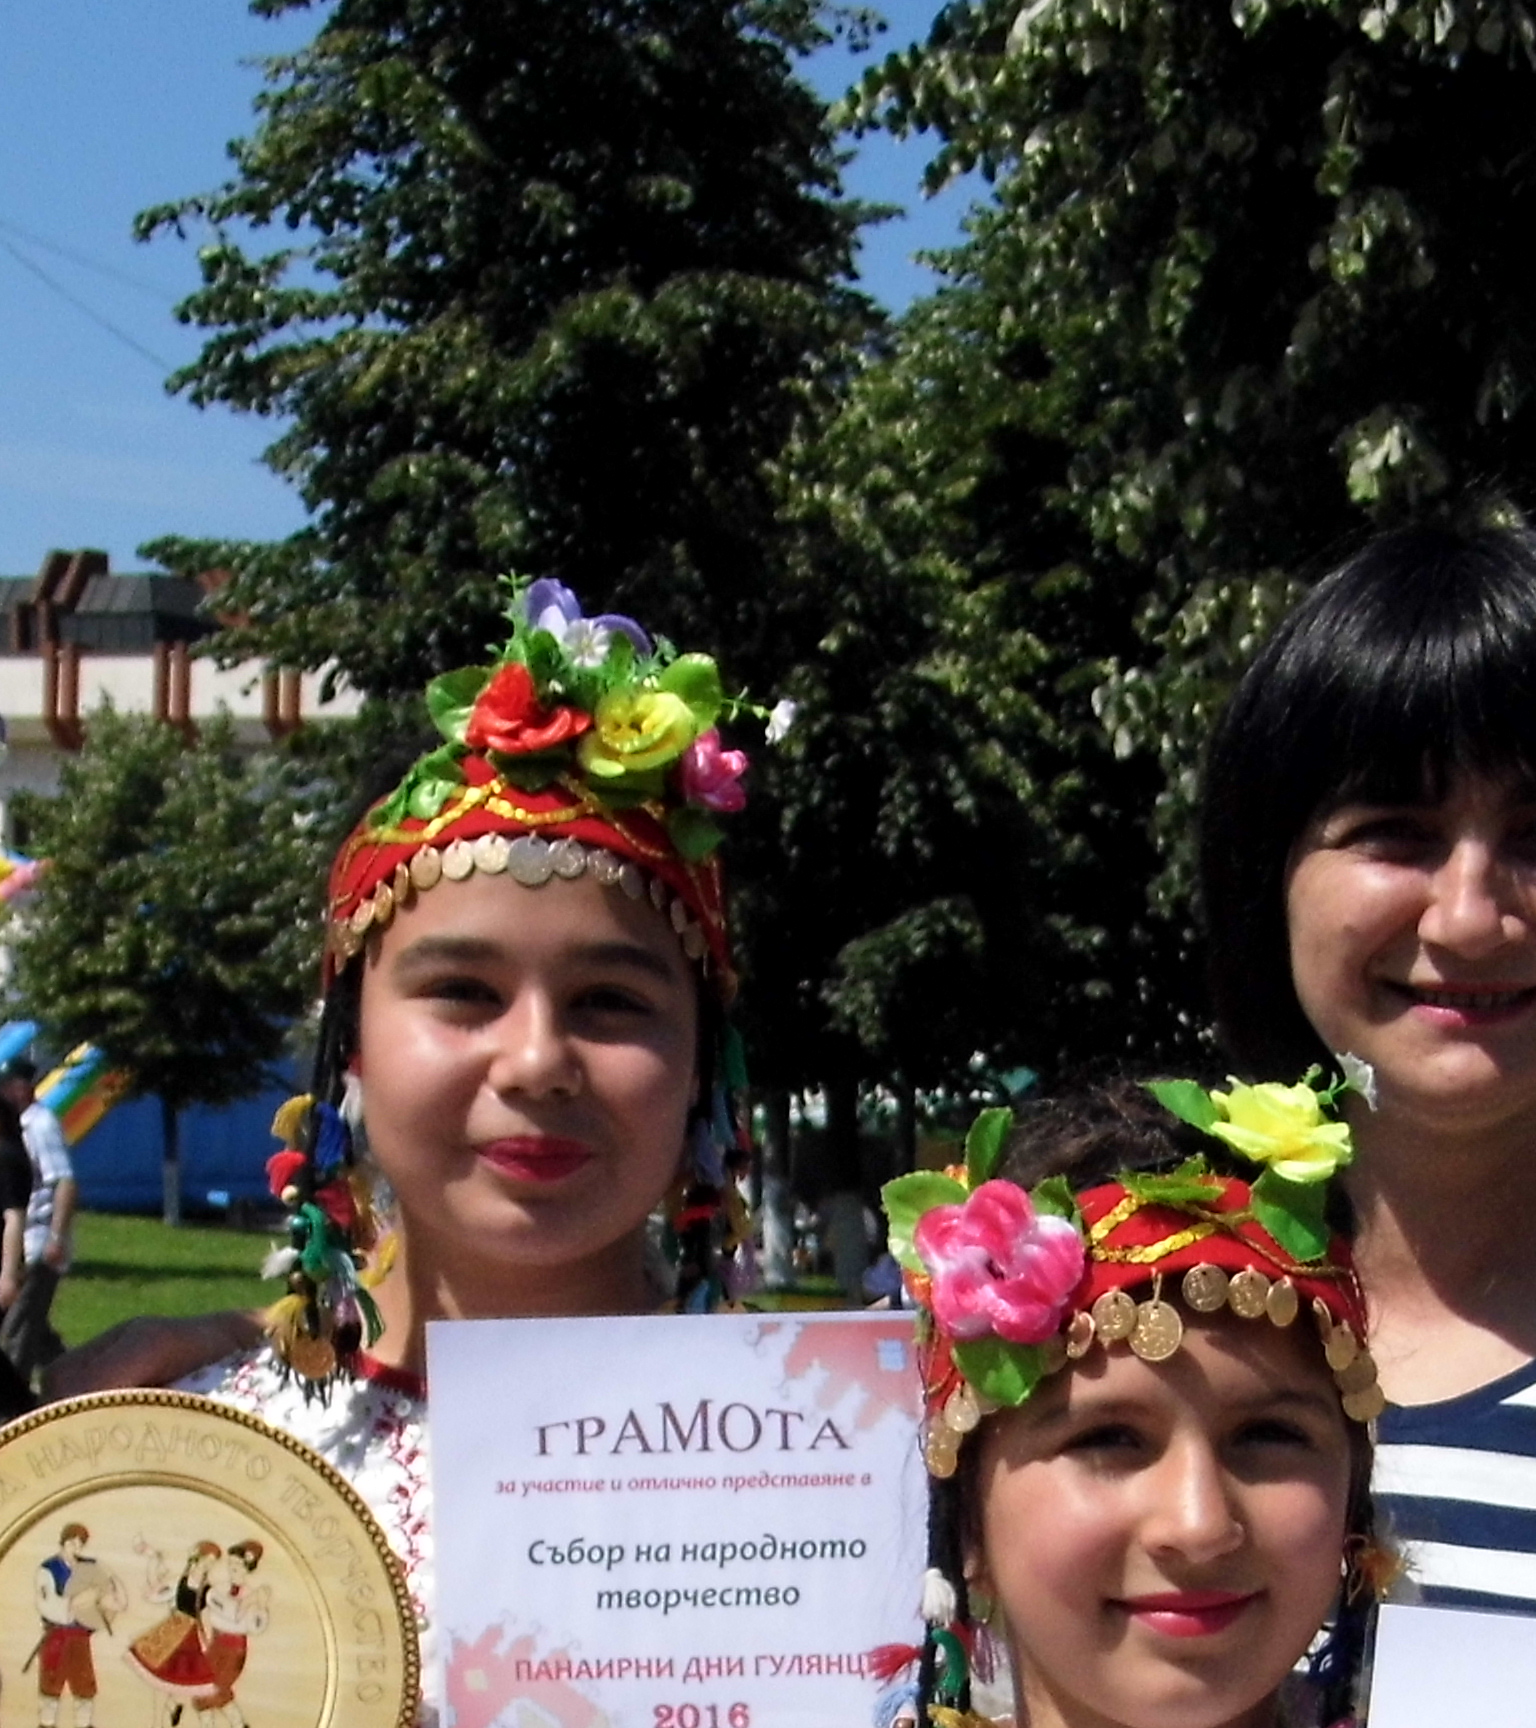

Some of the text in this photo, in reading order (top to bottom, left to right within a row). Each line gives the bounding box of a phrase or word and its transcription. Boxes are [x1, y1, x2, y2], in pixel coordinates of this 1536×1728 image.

[535, 1397, 851, 1457] ГРАМОТА
[26, 1420, 272, 1481] НАРОДНОТО
[494, 1469, 874, 1499] за участие и отлично представяне в
[527, 1533, 867, 1572] Събор на народното
[596, 1586, 801, 1616] творчество
[515, 1652, 866, 1685] ПАНАИРНИ ДНИ ГУЛЯНЦ
